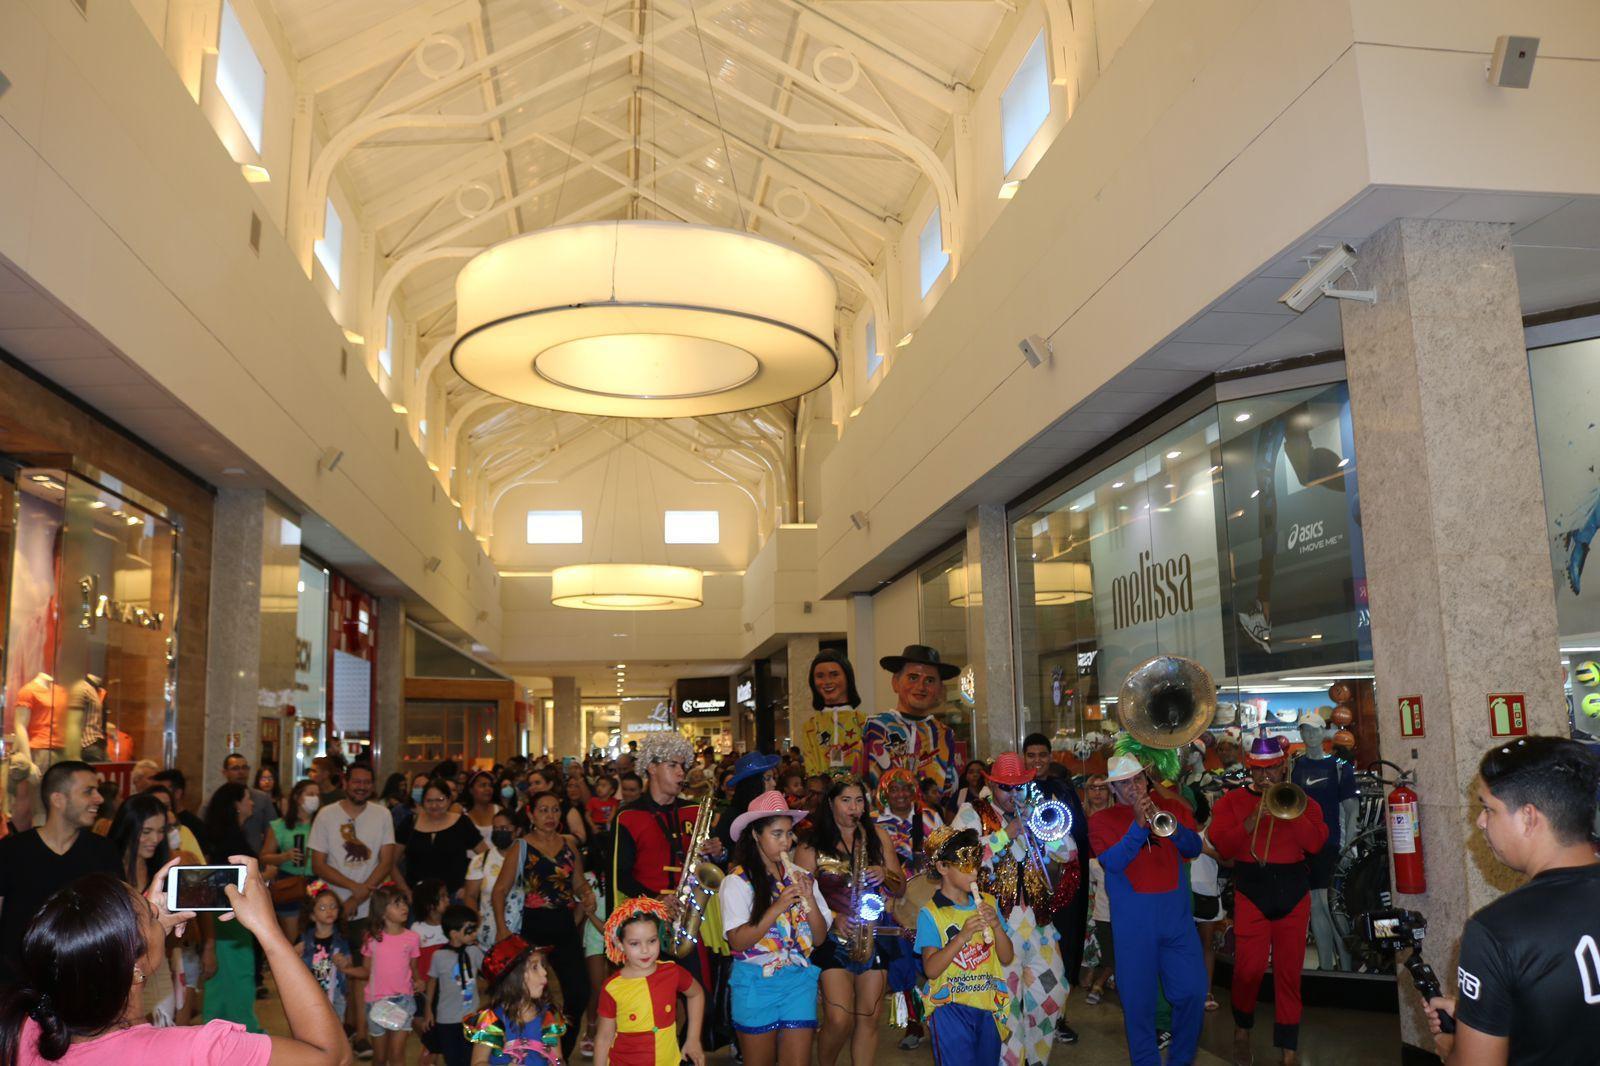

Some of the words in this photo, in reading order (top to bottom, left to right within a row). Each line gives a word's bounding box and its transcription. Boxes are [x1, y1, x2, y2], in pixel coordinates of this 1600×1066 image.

[1299, 520, 1323, 542] asics
[1303, 540, 1324, 552] MOVE
[1112, 550, 1193, 630] melissa
[685, 821, 693, 835] R
